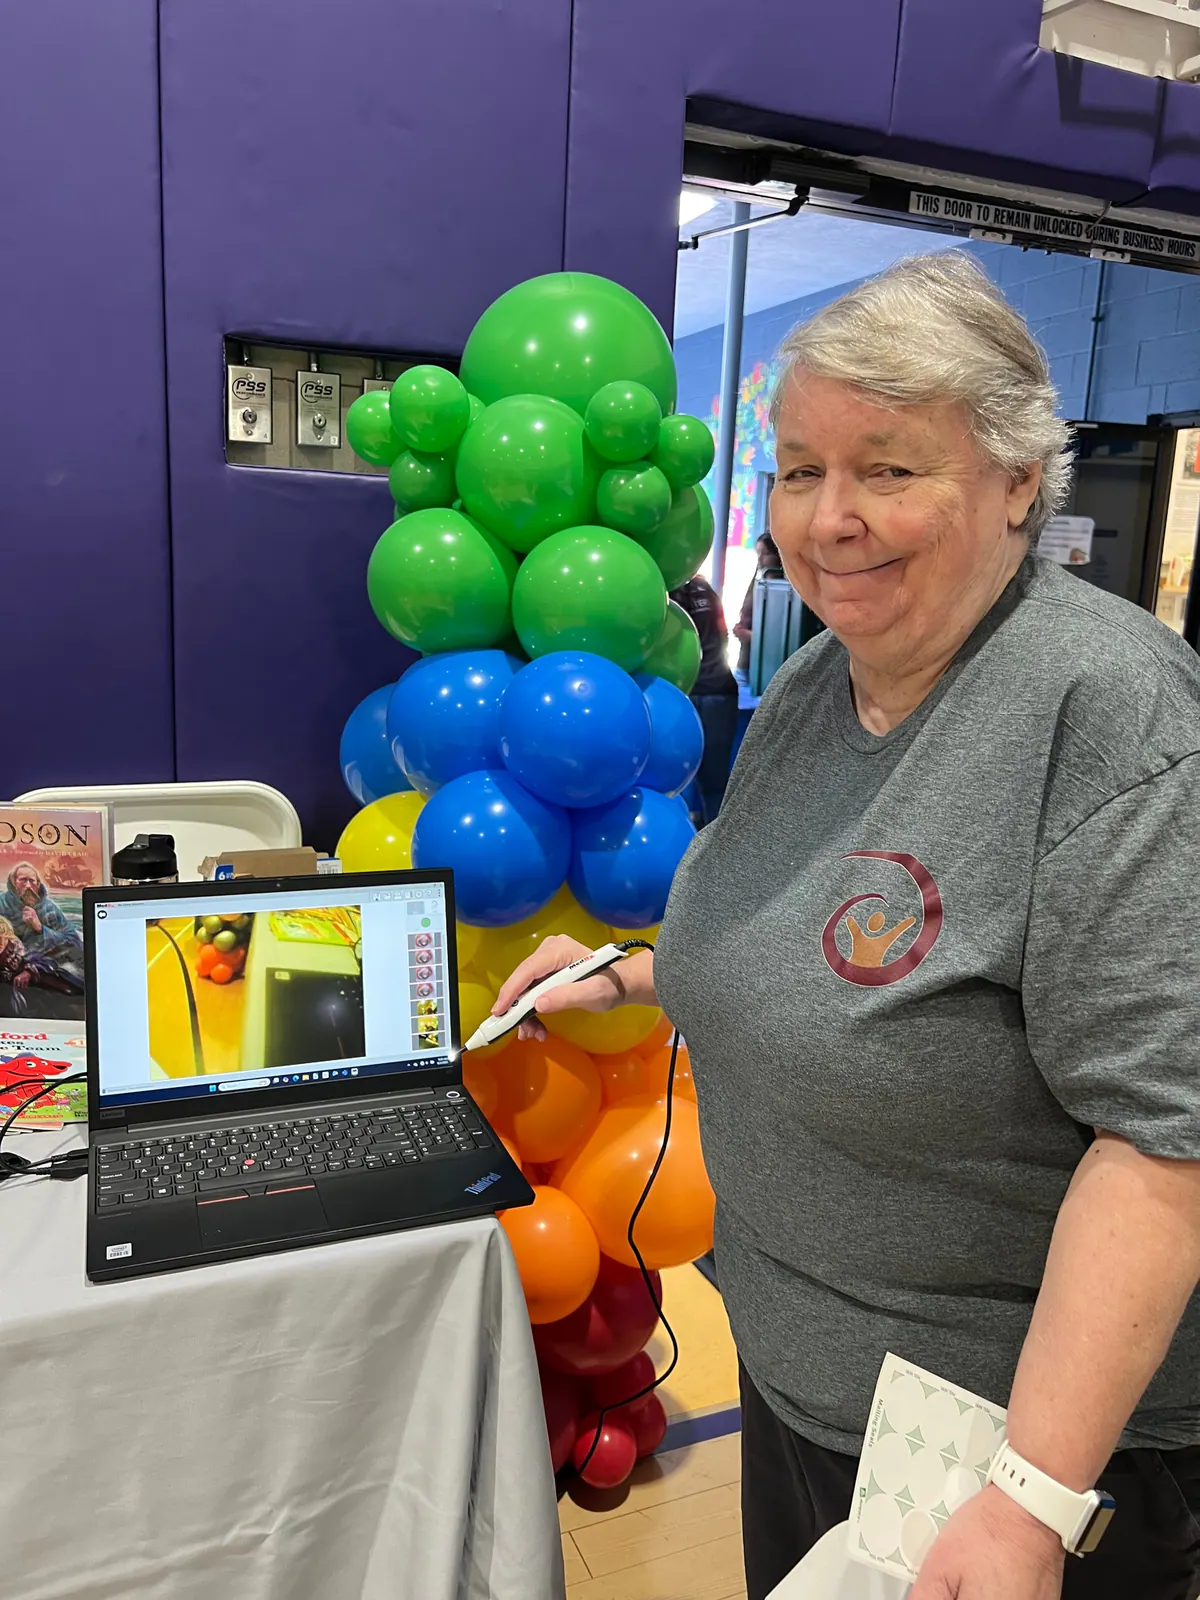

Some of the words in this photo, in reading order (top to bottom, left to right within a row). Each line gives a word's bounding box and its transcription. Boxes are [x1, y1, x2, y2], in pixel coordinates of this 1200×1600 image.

[915, 194, 940, 214] THIS
[944, 198, 973, 219] DOOR
[976, 204, 990, 222] TO
[993, 207, 1031, 230] REMAIN
[1034, 214, 1083, 238] UNLOCKED
[1085, 223, 1120, 245] DURING
[1122, 230, 1165, 253] BUSINESS
[1167, 238, 1197, 258] HOURS
[236, 380, 266, 392] PSS
[304, 384, 333, 395] PSS
[218, 871, 226, 881] 6
[0, 1032, 49, 1041] ford
[872, 1398, 884, 1426] Mailing
[868, 1426, 877, 1448] Seals
